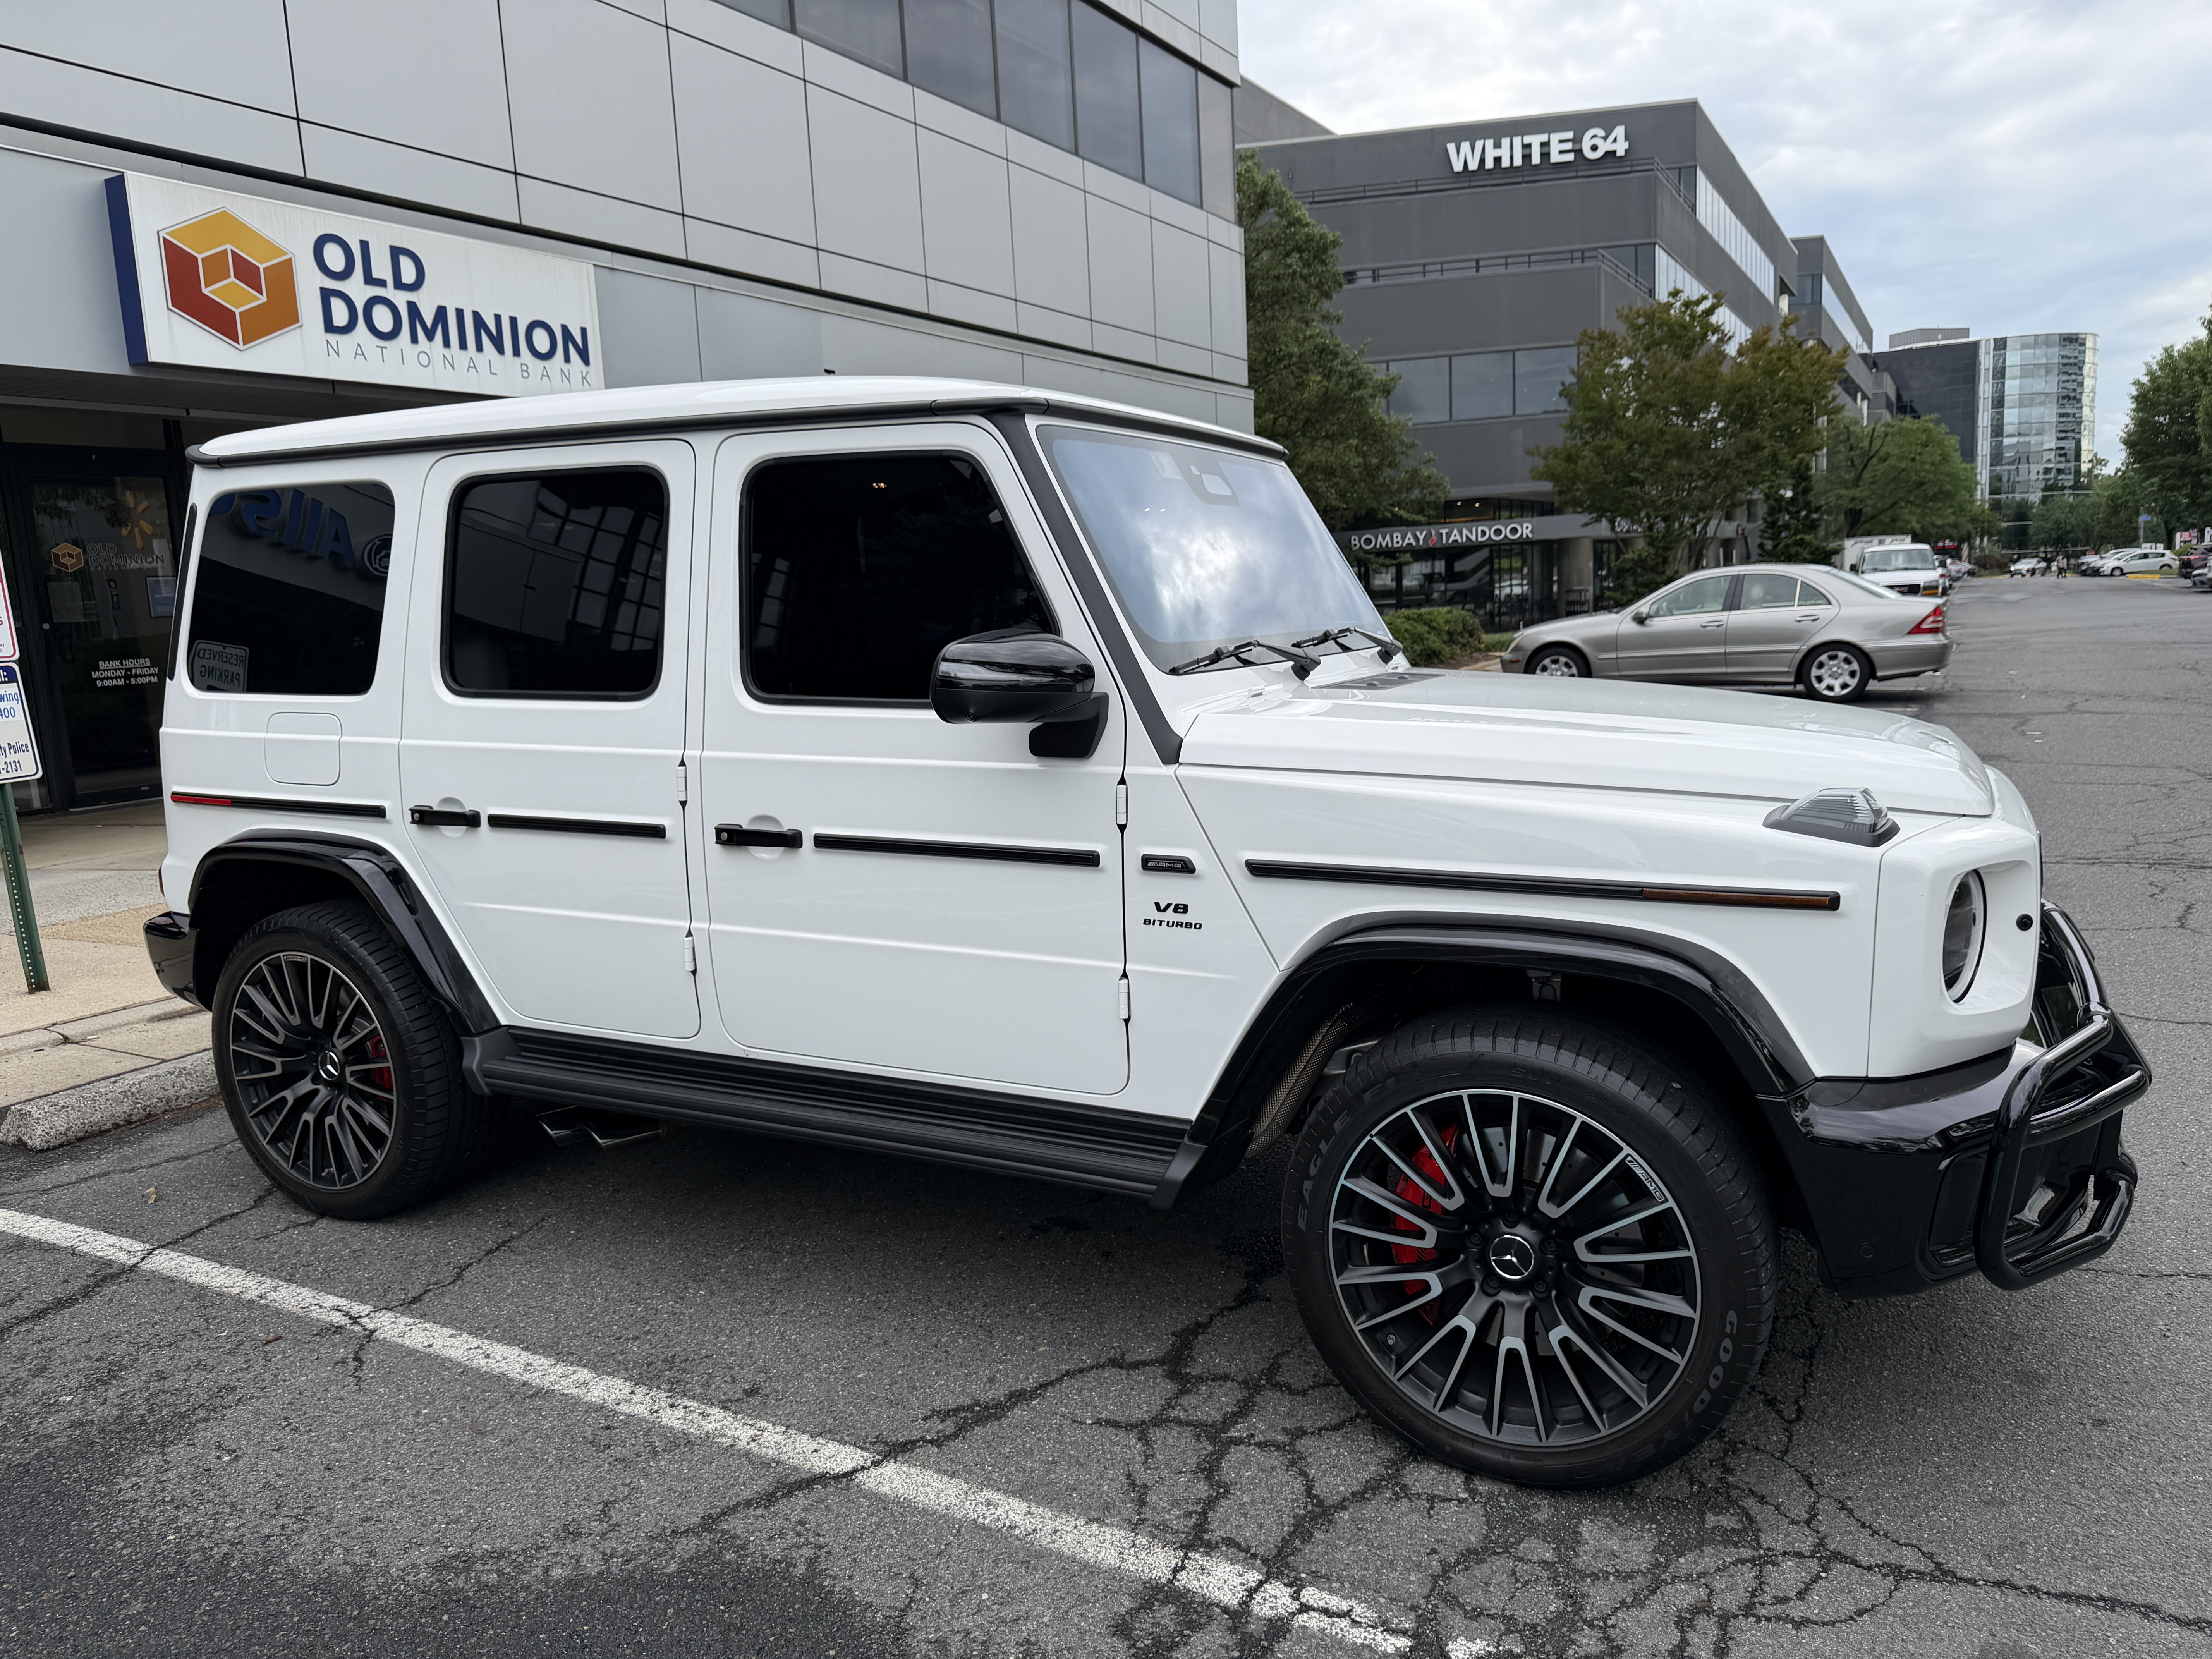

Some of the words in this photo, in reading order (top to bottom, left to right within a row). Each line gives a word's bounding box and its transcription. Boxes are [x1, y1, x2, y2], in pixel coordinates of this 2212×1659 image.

[1446, 130, 1575, 173] WHITE
[1582, 124, 1629, 160] 64
[313, 233, 426, 292] OLD
[319, 287, 591, 367] DOMINION
[326, 339, 498, 376] NATIONAL
[520, 363, 592, 387] BANK
[1351, 530, 1427, 550] BOMBAY
[1439, 522, 1533, 545] TANDOOR
[87, 543, 117, 555] OLD
[89, 553, 165, 566] DOMINION
[99, 660, 121, 668] BANK
[122, 658, 151, 666] HOURS
[91, 669, 125, 678] MONDAY
[132, 667, 159, 676] FRIDAY
[96, 678, 125, 687] 9:00AM
[131, 676, 158, 685] 5:00PM
[7, 741, 29, 755] Police
[1154, 901, 1189, 914] V8
[1143, 918, 1202, 930] BITURBO
[1297, 1109, 1350, 1232] EAGLE
